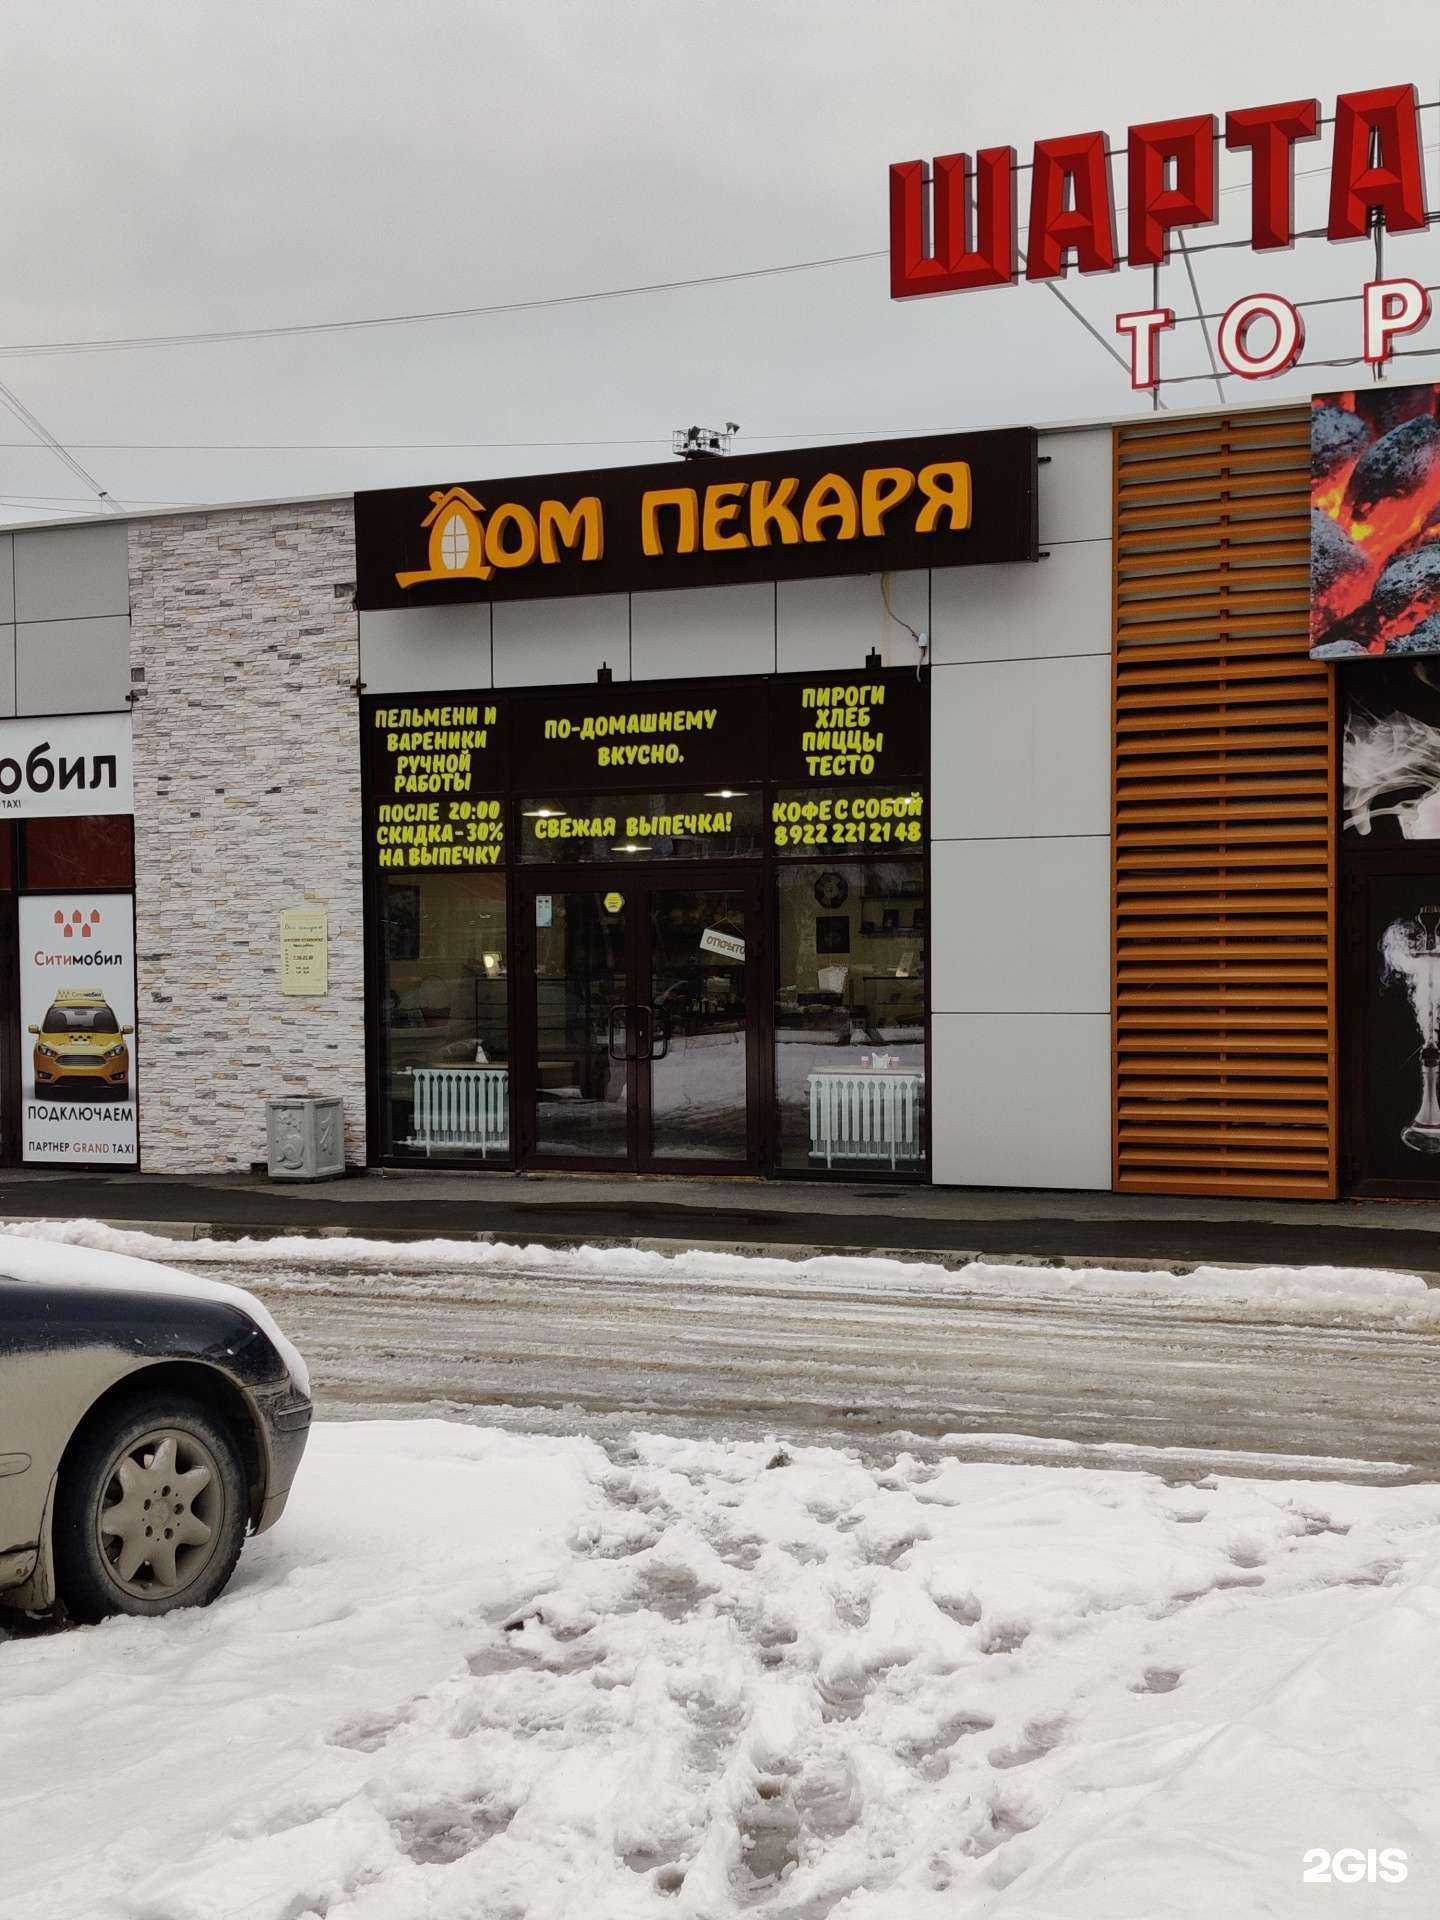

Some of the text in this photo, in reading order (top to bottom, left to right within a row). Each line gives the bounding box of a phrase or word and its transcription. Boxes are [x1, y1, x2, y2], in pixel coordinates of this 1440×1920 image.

[889, 83, 1430, 302] ШАРТА
[1115, 278, 1432, 390] ТОР
[641, 461, 973, 556] ПЕКАРЯ
[801, 685, 886, 708] ПИРОГИ
[375, 706, 497, 728] ПЕЛЬМЕНИ И
[544, 709, 718, 740] ПО-ДОМАШНЕМУ
[815, 706, 871, 729] ХЛЕБ
[386, 730, 488, 752] ВАРЕНИКИ
[801, 729, 884, 754] ПИЦЦЫ
[397, 749, 472, 774] РУЧНОЙ
[597, 743, 685, 767] ВКУСНО.
[805, 754, 875, 777] ТЕСТО
[0, 741, 117, 795] обил
[394, 772, 472, 793] РАБОТЫ
[378, 800, 501, 823] ПОСЛЕ 20:00
[771, 791, 924, 823] КОФЕ С СОБОЙ
[534, 811, 733, 839] СВЕЖАЯ ВЫПЕЧКА!
[894, 820, 922, 843] 48
[378, 844, 502, 867] НА ВЫПЕЧКУ
[34, 950, 123, 967] Ситимобил
[28, 1105, 134, 1123] ПОДКЛЮЧАЕМ
[28, 1141, 135, 1155] ПАРТНЕР GRAND TAXI
